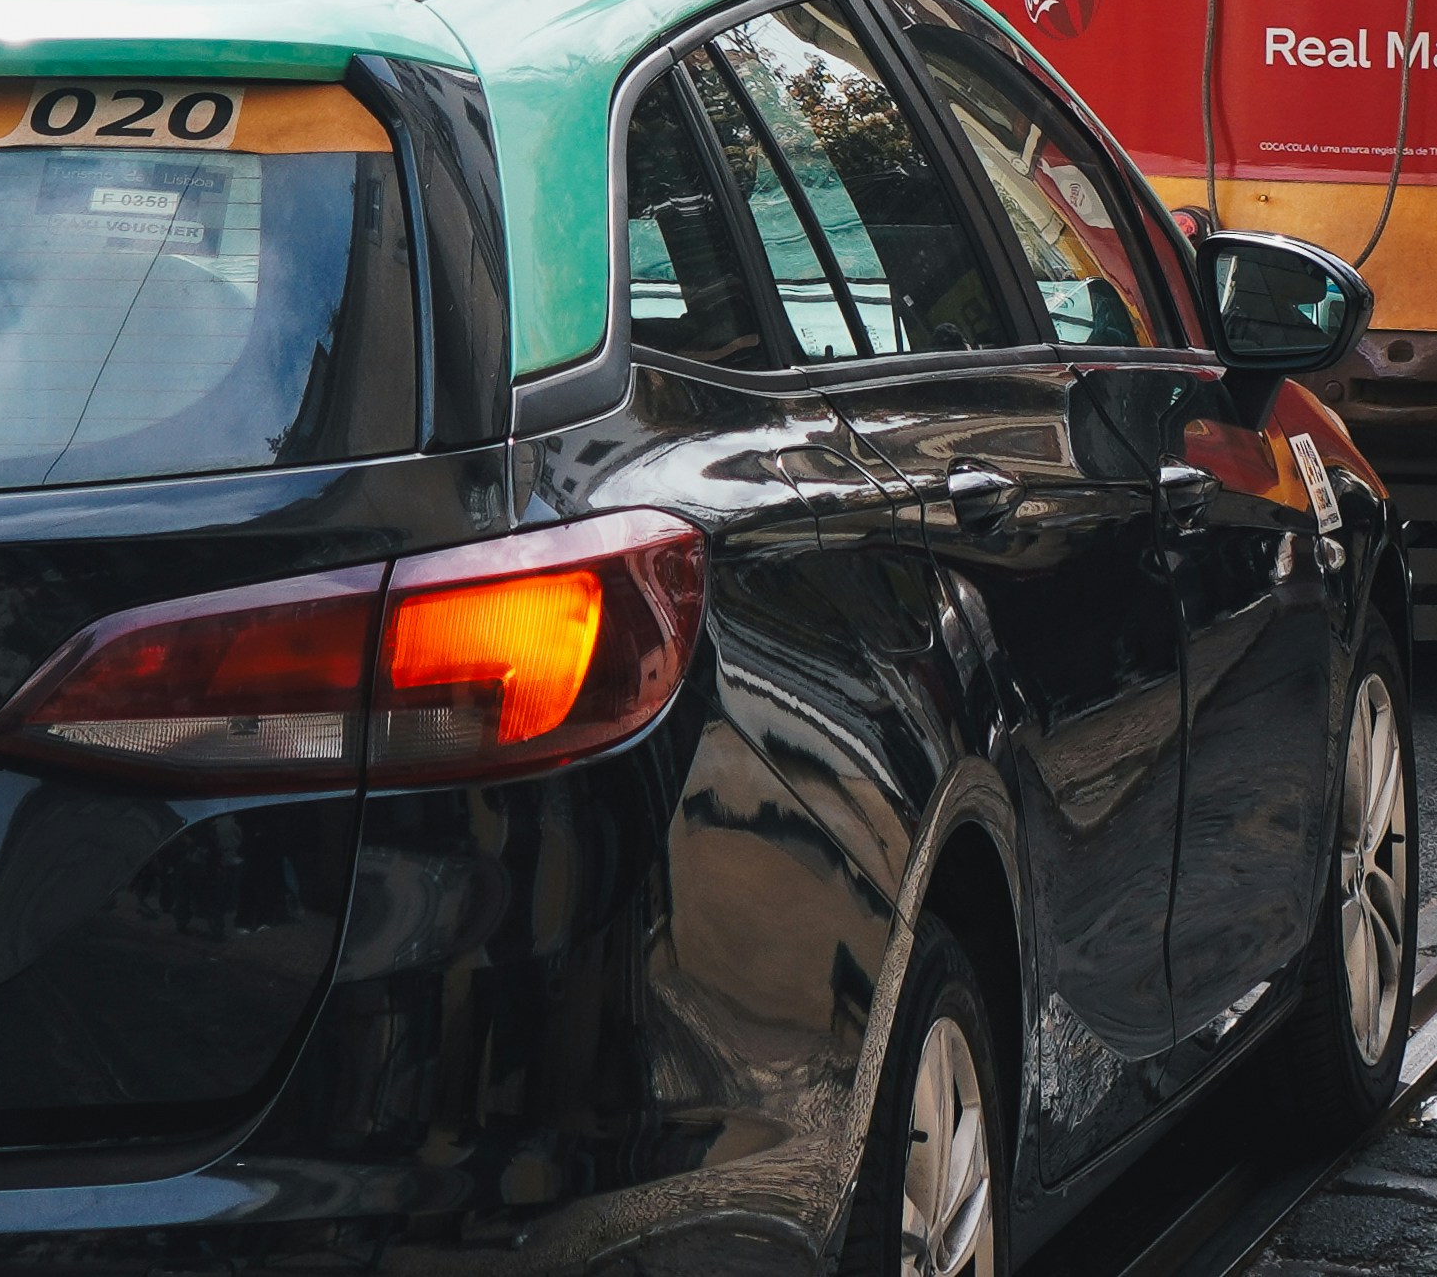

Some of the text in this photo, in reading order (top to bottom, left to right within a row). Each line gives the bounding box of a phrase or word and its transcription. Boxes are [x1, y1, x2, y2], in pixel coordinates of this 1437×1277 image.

[1265, 27, 1372, 69] Real
[30, 86, 234, 141] 020
[1320, 146, 1340, 154] uma
[1341, 146, 1370, 155] marca
[1370, 146, 1414, 157] registda
[1415, 148, 1428, 157] de
[163, 172, 215, 188] Lisboa
[102, 192, 169, 208] F 0358
[106, 220, 200, 239] VOUCHER
